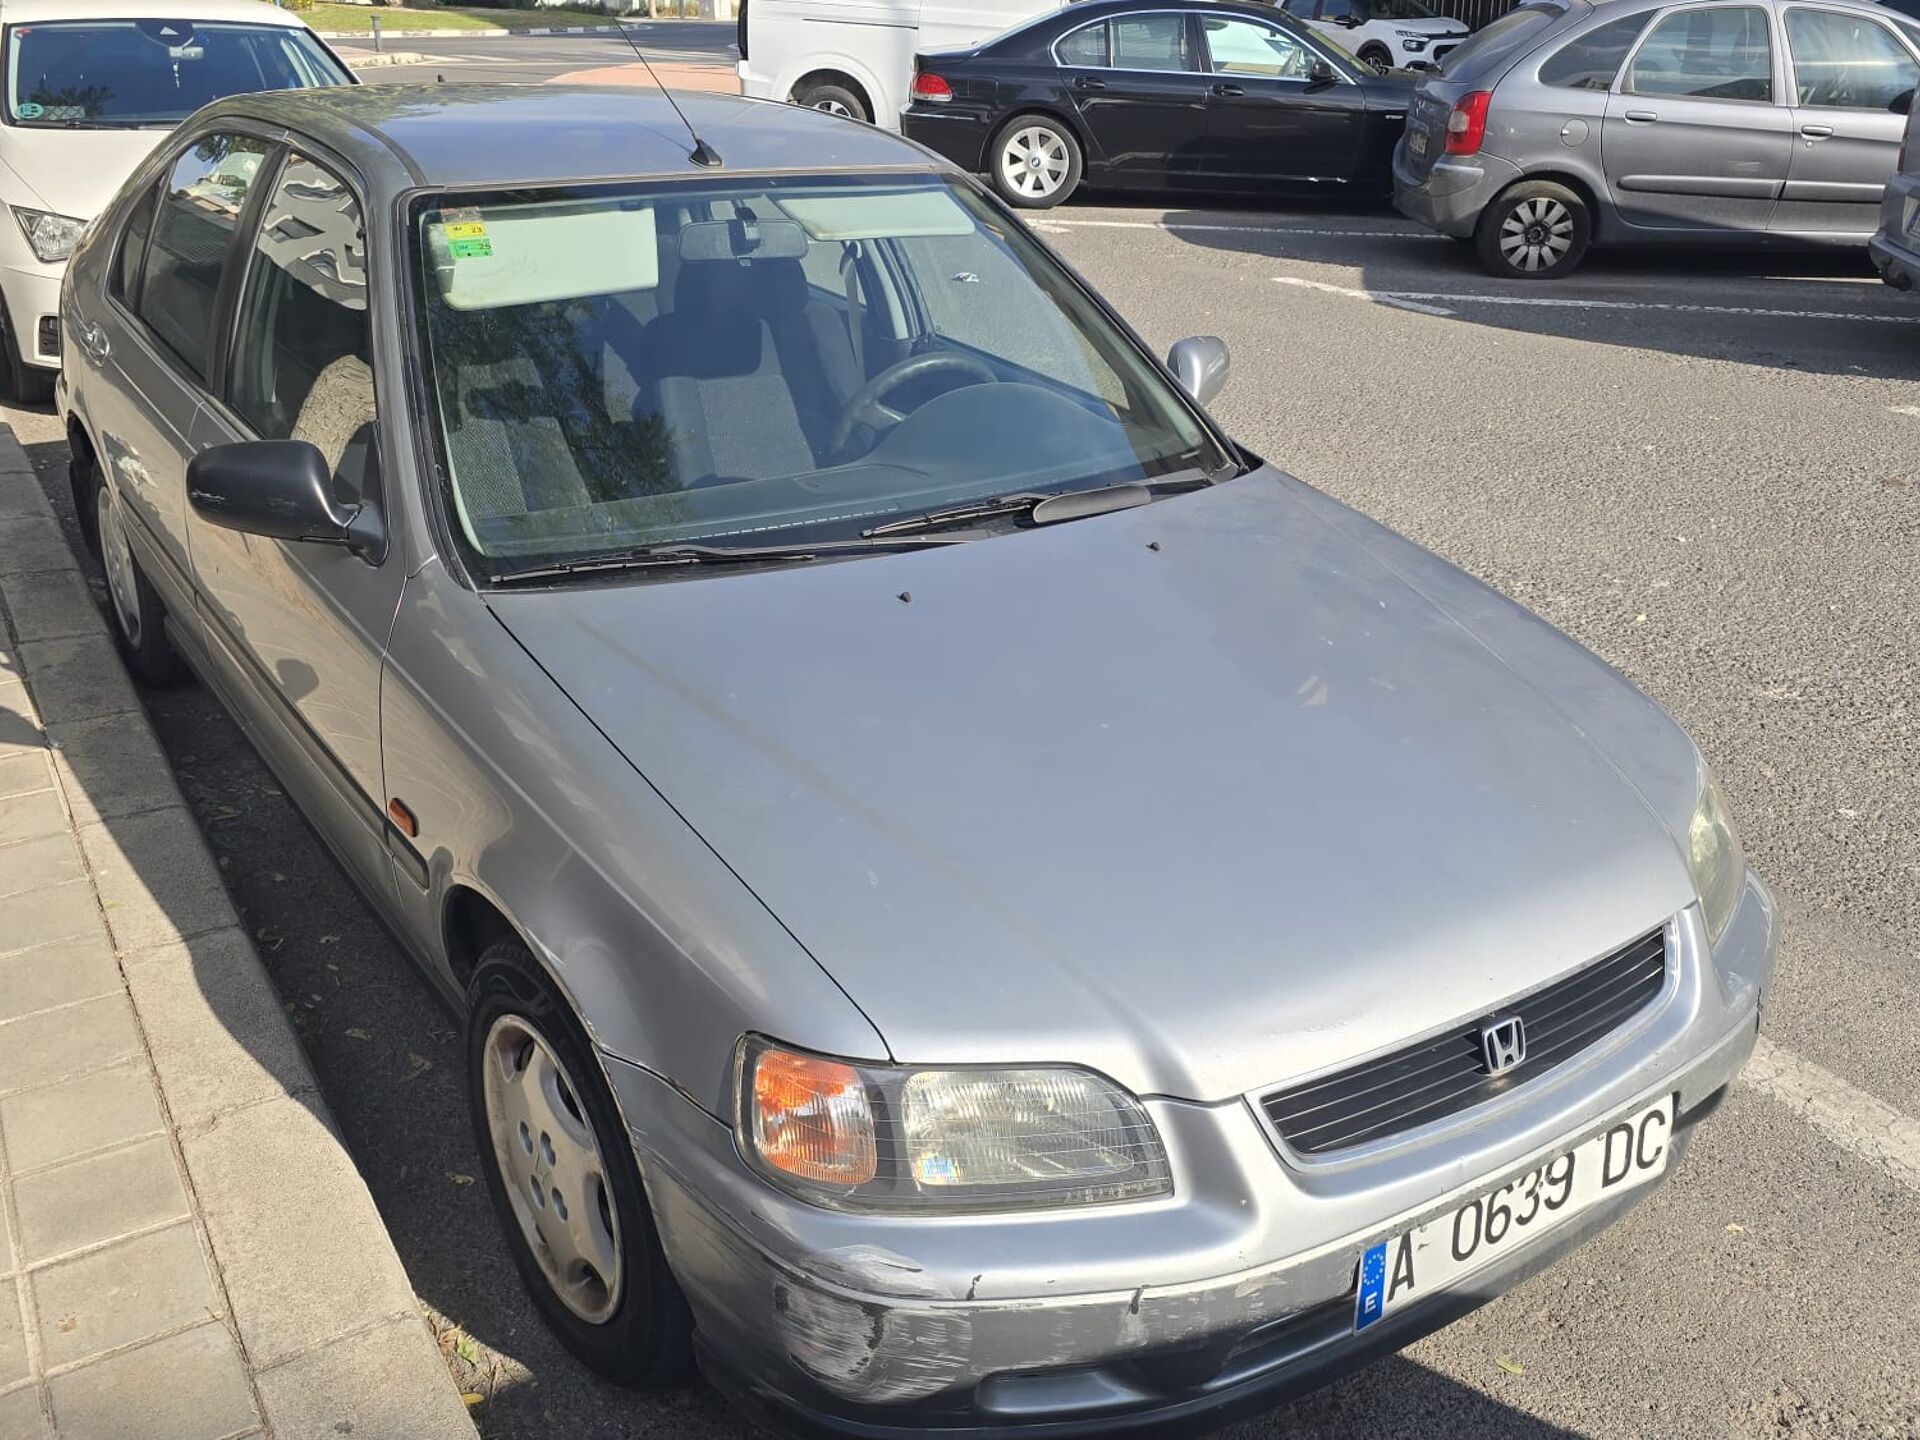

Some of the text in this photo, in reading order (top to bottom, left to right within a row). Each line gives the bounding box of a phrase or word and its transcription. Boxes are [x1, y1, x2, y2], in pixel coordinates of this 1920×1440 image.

[1386, 1109, 1666, 1303] A 0639 DC
[1363, 1291, 1379, 1315] E
